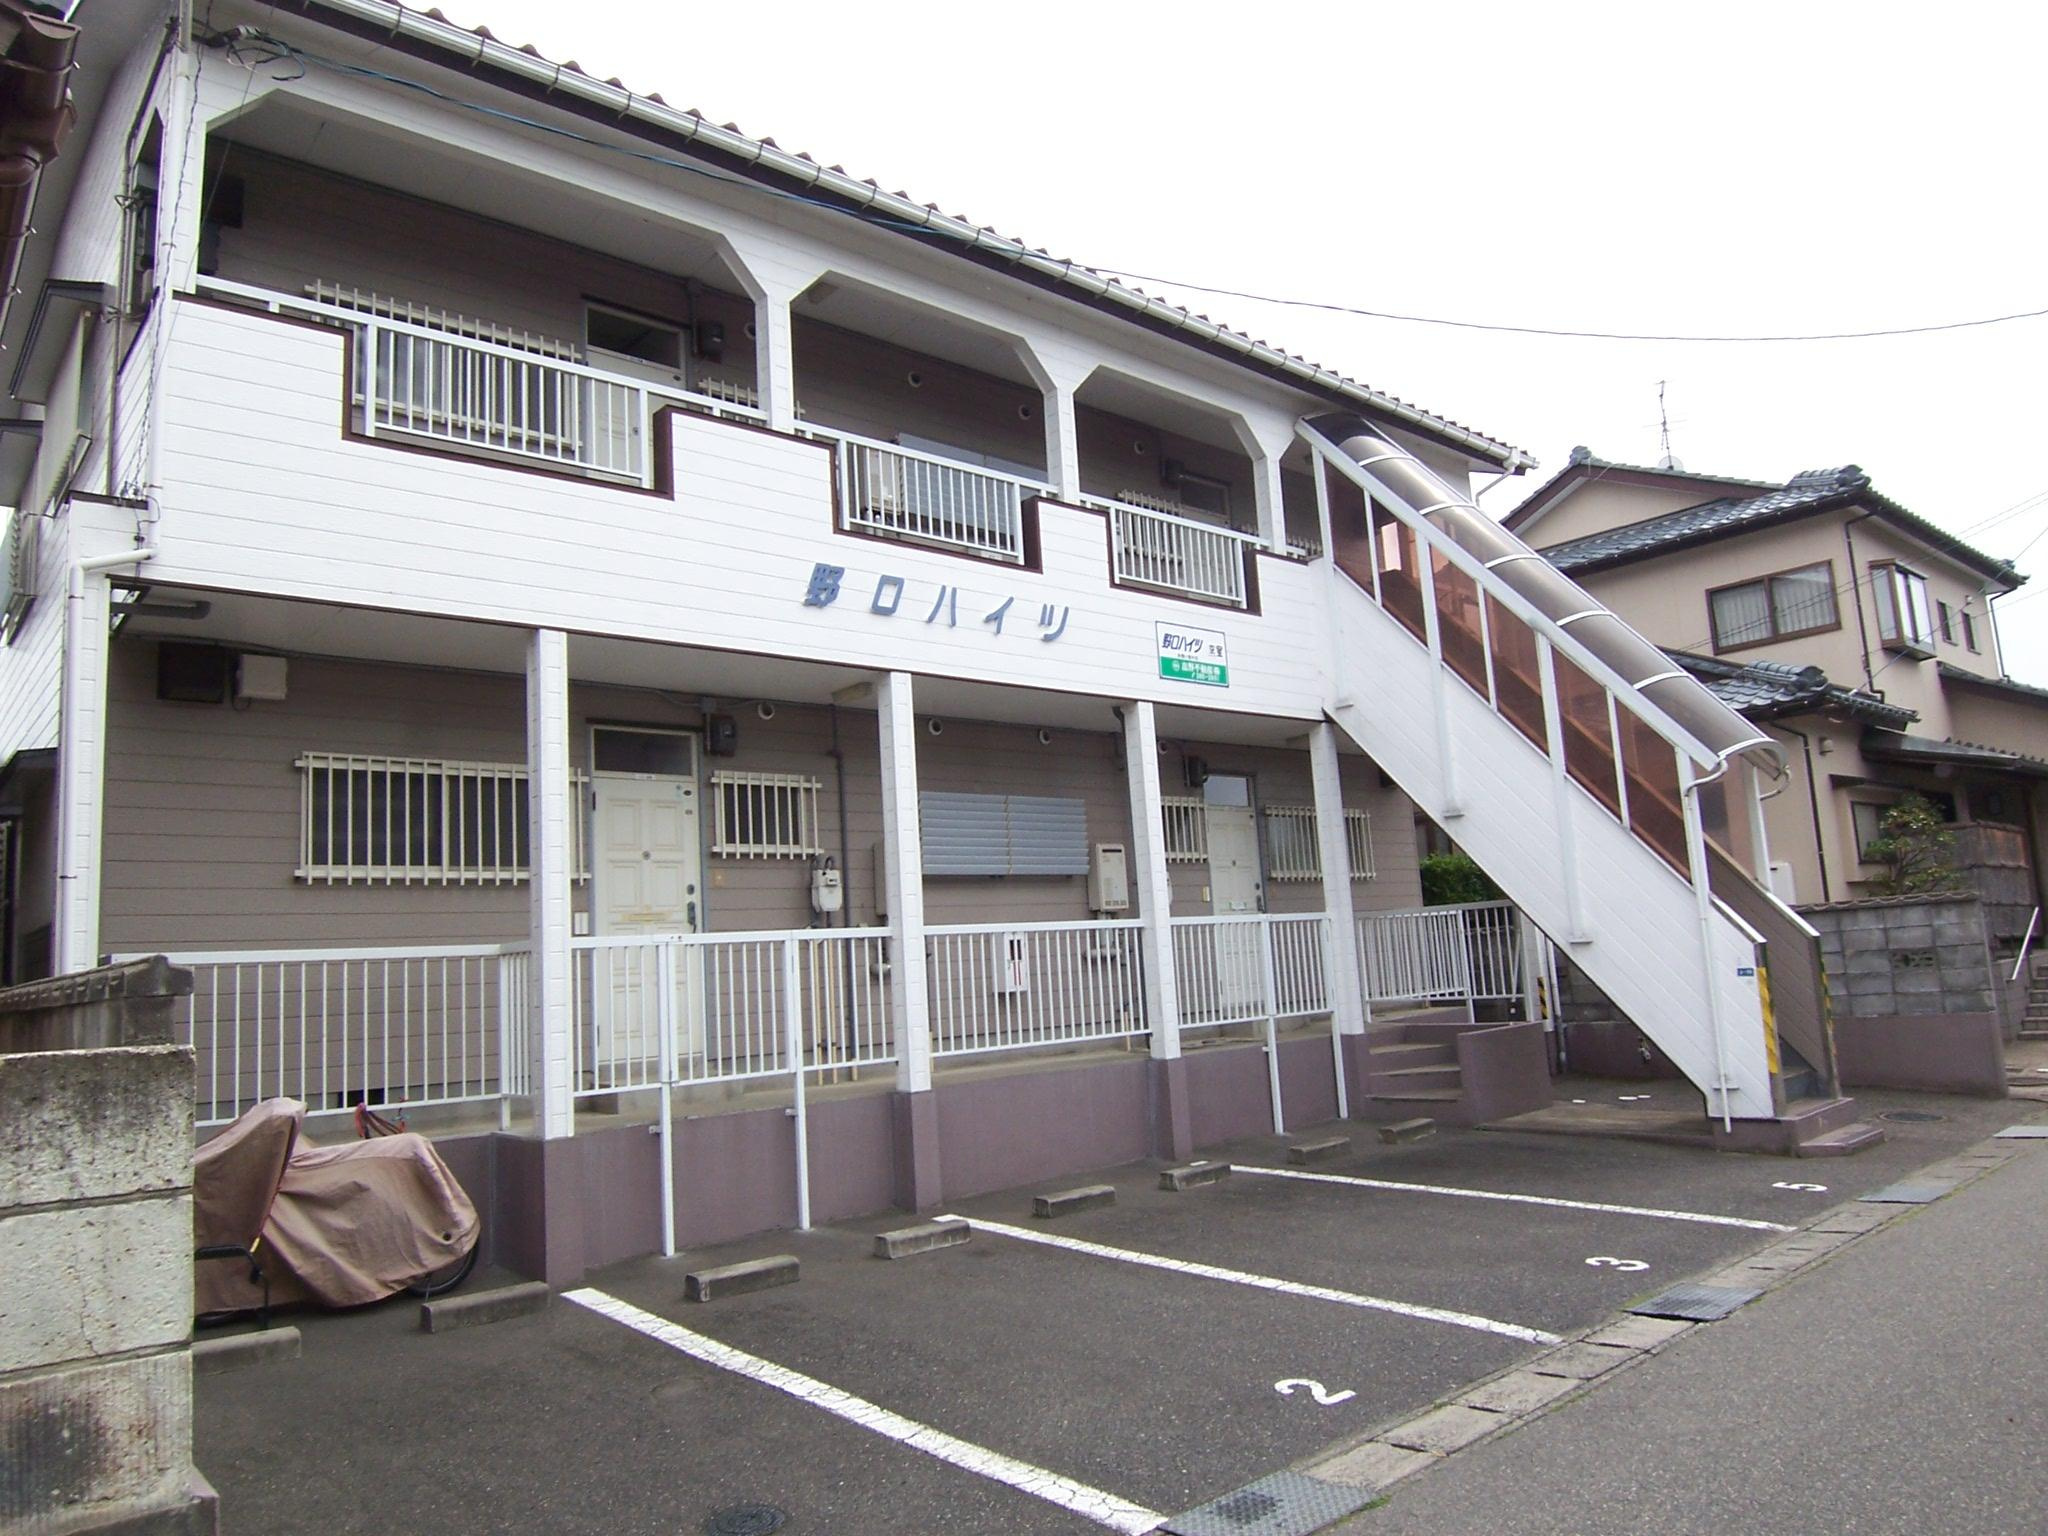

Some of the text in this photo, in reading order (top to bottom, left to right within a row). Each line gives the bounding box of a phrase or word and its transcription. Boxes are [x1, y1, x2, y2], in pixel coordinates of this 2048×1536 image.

[803, 562, 1069, 642] 野口ハイツ
[1162, 633, 1204, 653] 野口ハイツ
[1771, 1181, 1828, 1192] 5
[1584, 1256, 1650, 1271] 3
[1274, 1378, 1357, 1406] 2
